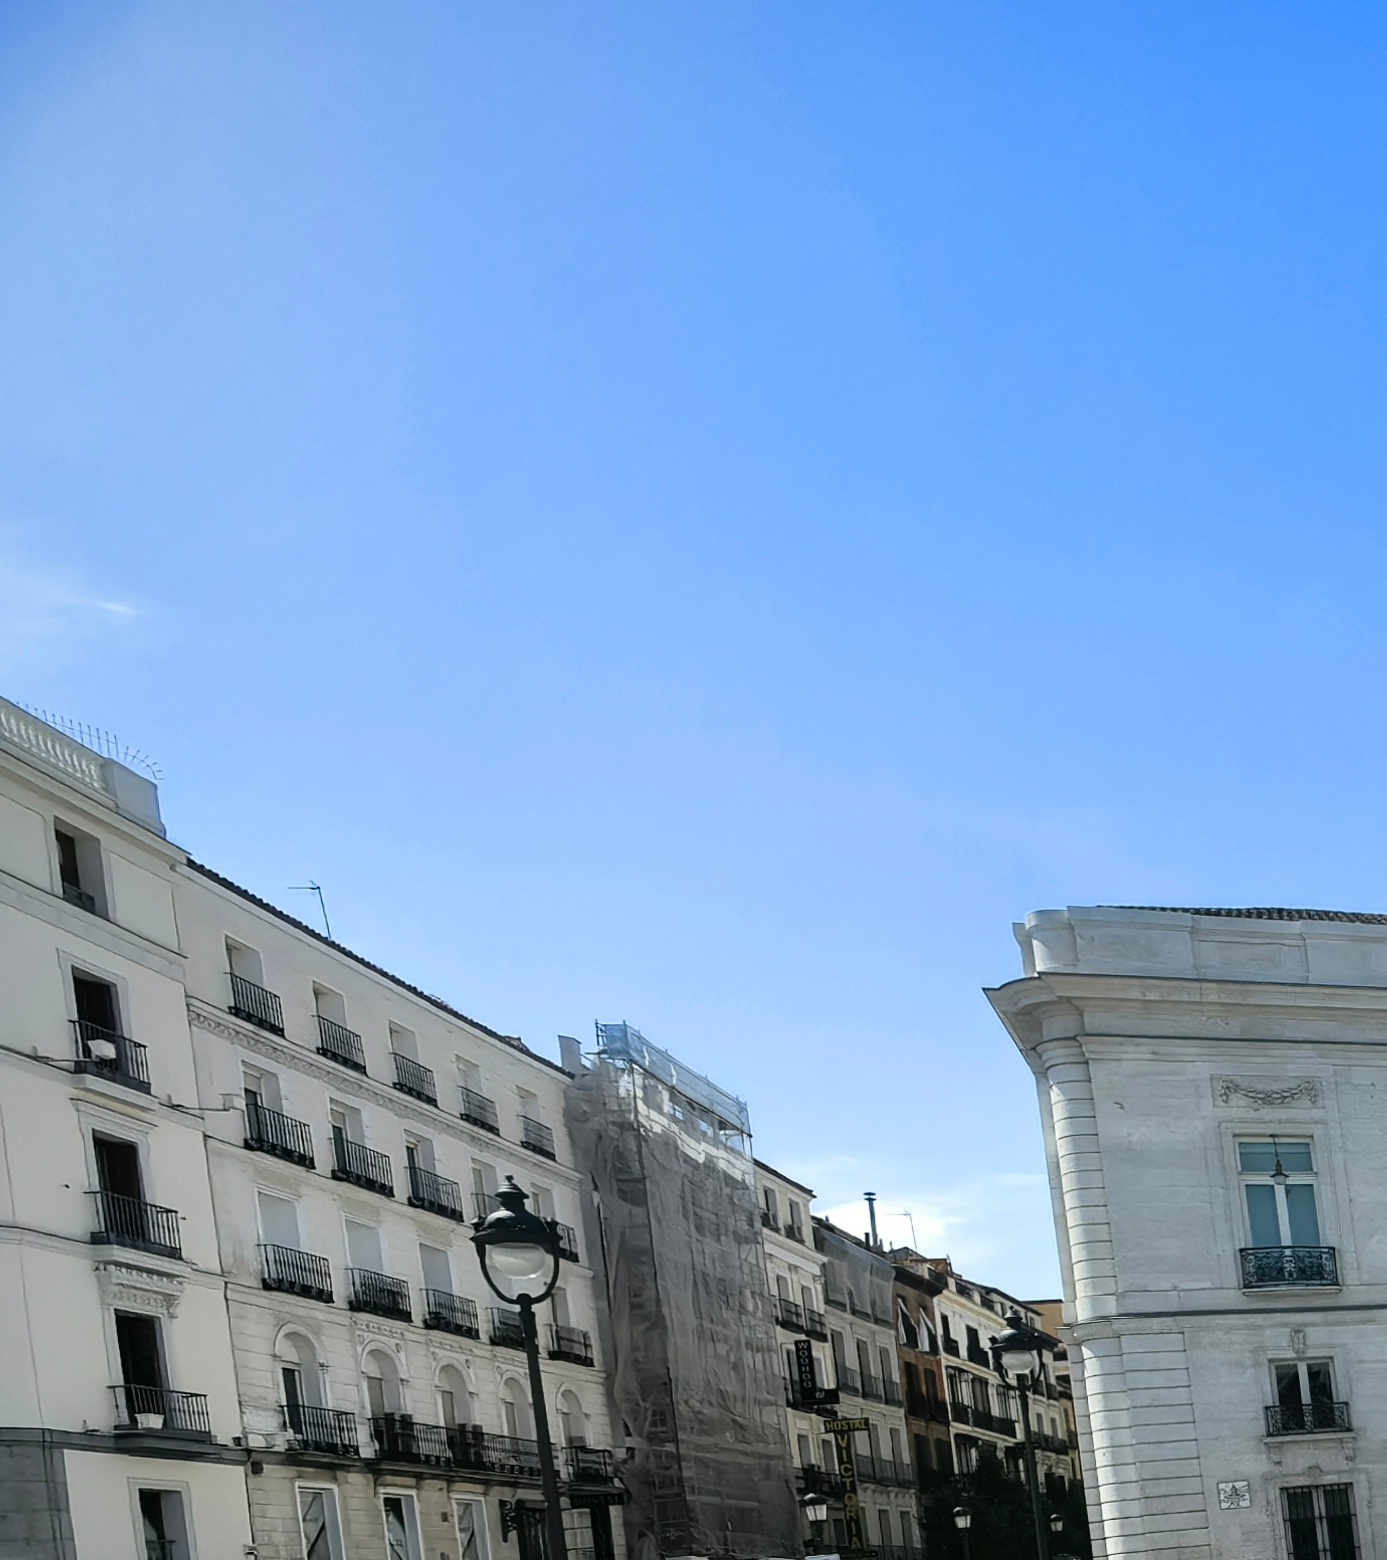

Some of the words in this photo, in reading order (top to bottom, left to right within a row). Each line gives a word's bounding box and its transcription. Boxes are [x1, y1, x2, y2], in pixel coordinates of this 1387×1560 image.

[797, 1341, 812, 1388] WOOHOO
[826, 1420, 868, 1432] HOSTAL
[837, 1433, 861, 1550] VICTORIA
